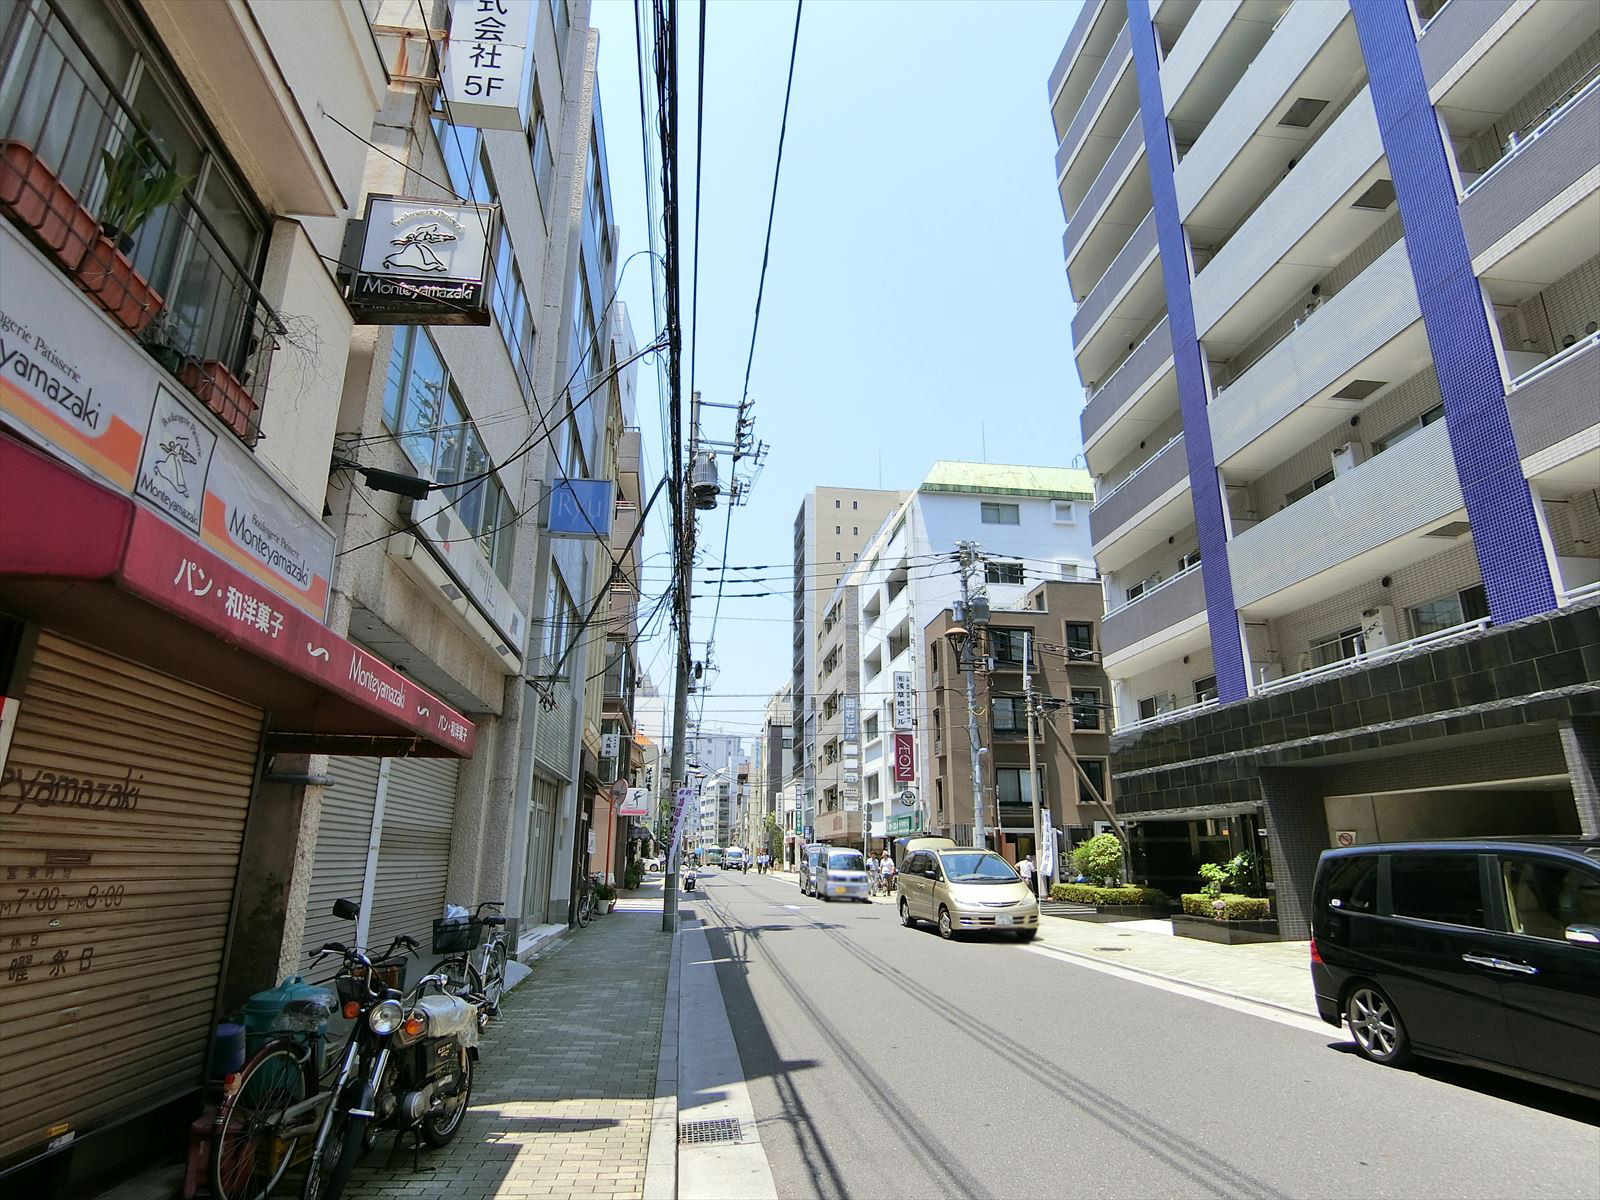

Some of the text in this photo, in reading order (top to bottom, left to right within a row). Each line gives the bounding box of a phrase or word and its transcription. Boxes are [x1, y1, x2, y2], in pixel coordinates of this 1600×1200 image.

[463, 74, 505, 97] 5F
[362, 278, 475, 300] Monteyamazaki
[34, 335, 82, 384] Patisserie
[140, 473, 200, 525] Monteyamazaki
[556, 491, 602, 528] Ryu
[229, 506, 310, 587] Monteyamazaki
[251, 513, 282, 545] Boulangerie
[173, 557, 285, 639] パン・和洋菓子
[348, 650, 406, 710] Monteyamazaki
[437, 713, 469, 743] パン・和洋菓子
